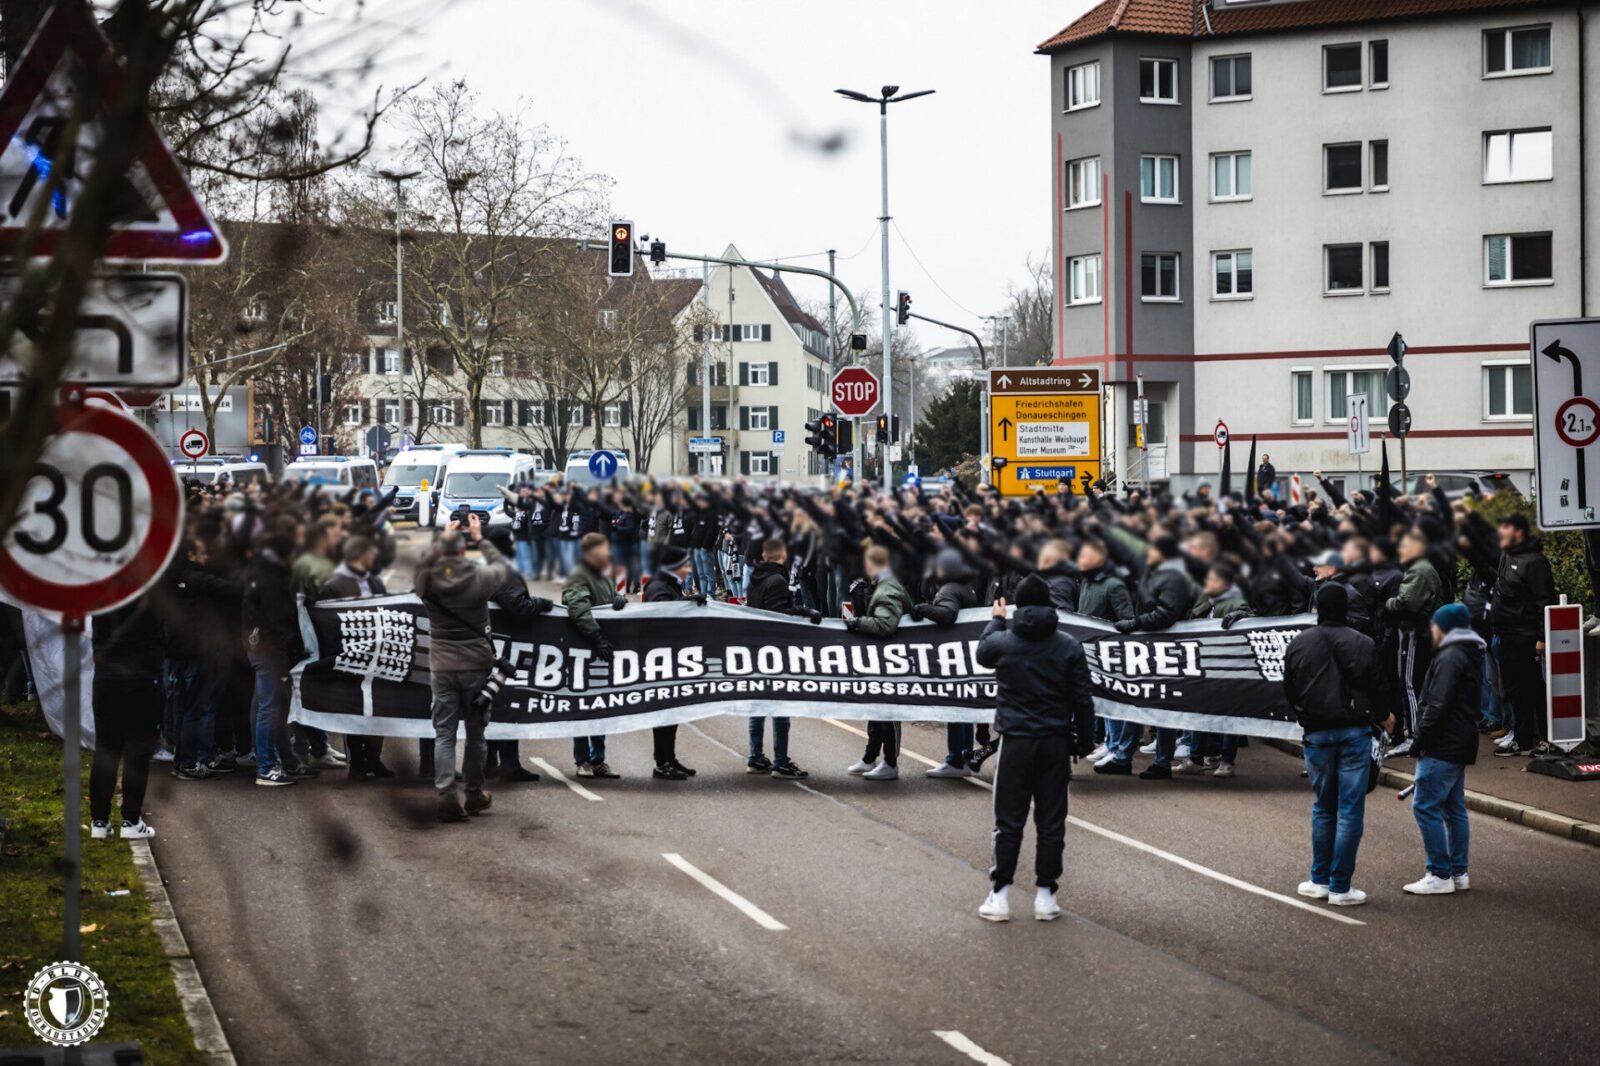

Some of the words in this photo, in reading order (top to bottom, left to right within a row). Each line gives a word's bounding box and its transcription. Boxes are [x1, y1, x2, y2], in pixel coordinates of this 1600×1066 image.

[1019, 376, 1071, 387] Altstadtring
[834, 381, 875, 401] STOP
[1015, 400, 1083, 408] Friedrichshafen
[1015, 410, 1087, 420] Donaueschingen
[1019, 424, 1064, 433] Stadtmitte
[774, 431, 783, 440] P
[1019, 435, 1053, 444] Kunsthalle
[1055, 435, 1087, 445] Weishaupt
[1019, 446, 1038, 455] Ulmer
[1040, 446, 1067, 455] Museum
[1034, 468, 1074, 479] Stuttgart
[13, 462, 134, 555] 30
[613, 646, 704, 686] DAS
[1098, 641, 1201, 676] FREI
[528, 694, 571, 713] FÜR
[579, 679, 765, 711] LANGFRISTIGEN
[773, 680, 948, 698] PROFIFUSSBALL
[957, 683, 977, 698] IN
